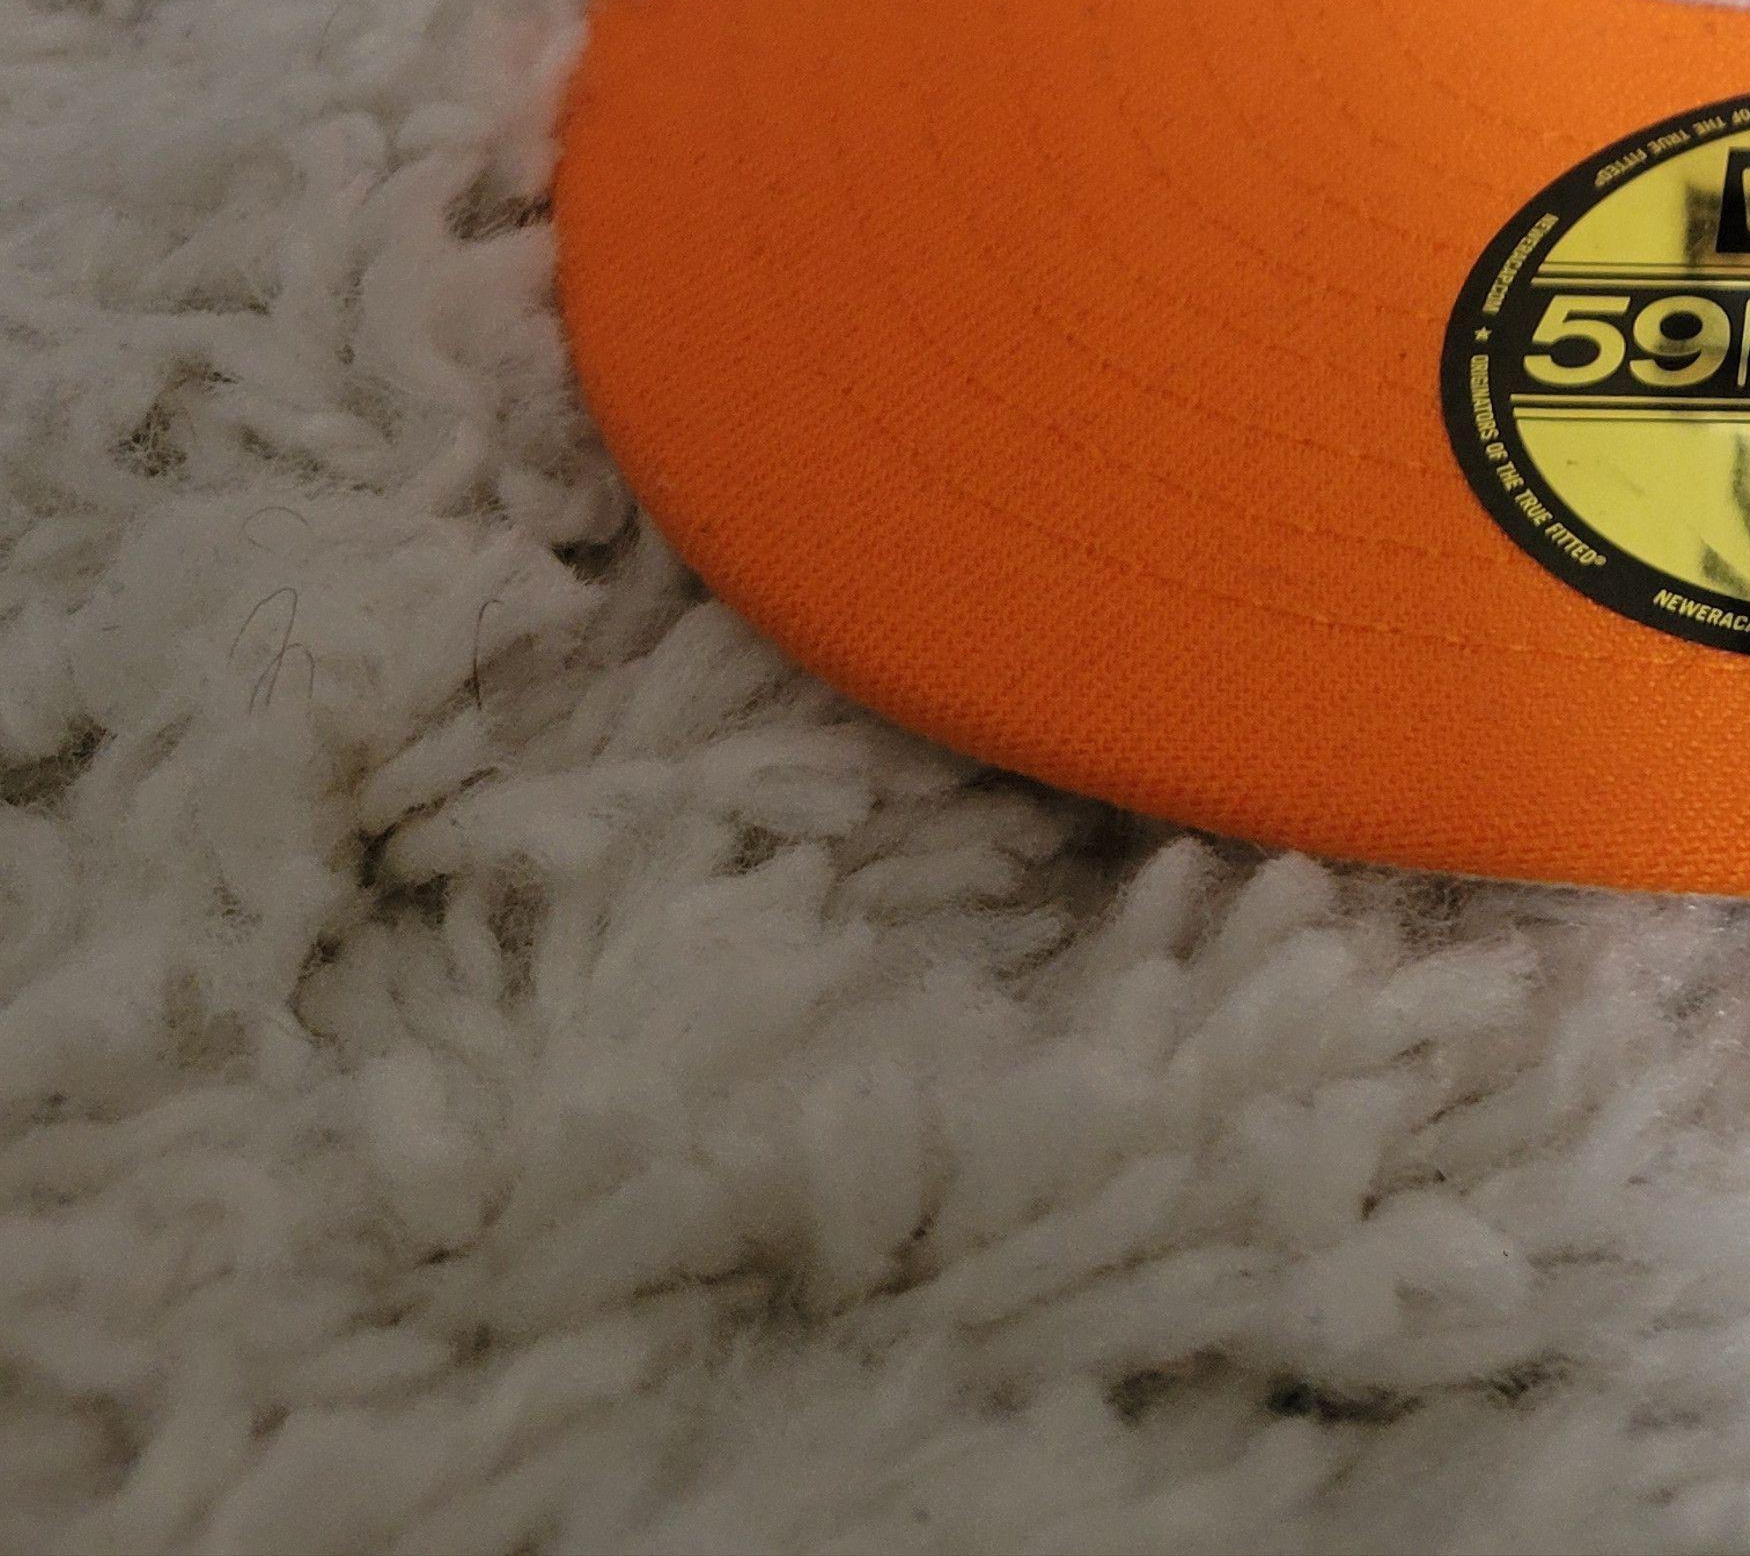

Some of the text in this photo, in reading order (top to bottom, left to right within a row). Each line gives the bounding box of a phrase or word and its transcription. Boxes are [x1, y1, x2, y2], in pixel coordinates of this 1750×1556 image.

[1692, 115, 1727, 136] THE
[1646, 128, 1692, 155] TRUE
[1470, 354, 1500, 441] ORIGINATORS
[1485, 441, 1509, 461] OF
[1496, 460, 1525, 491] THE
[1514, 488, 1554, 528] TRUE
